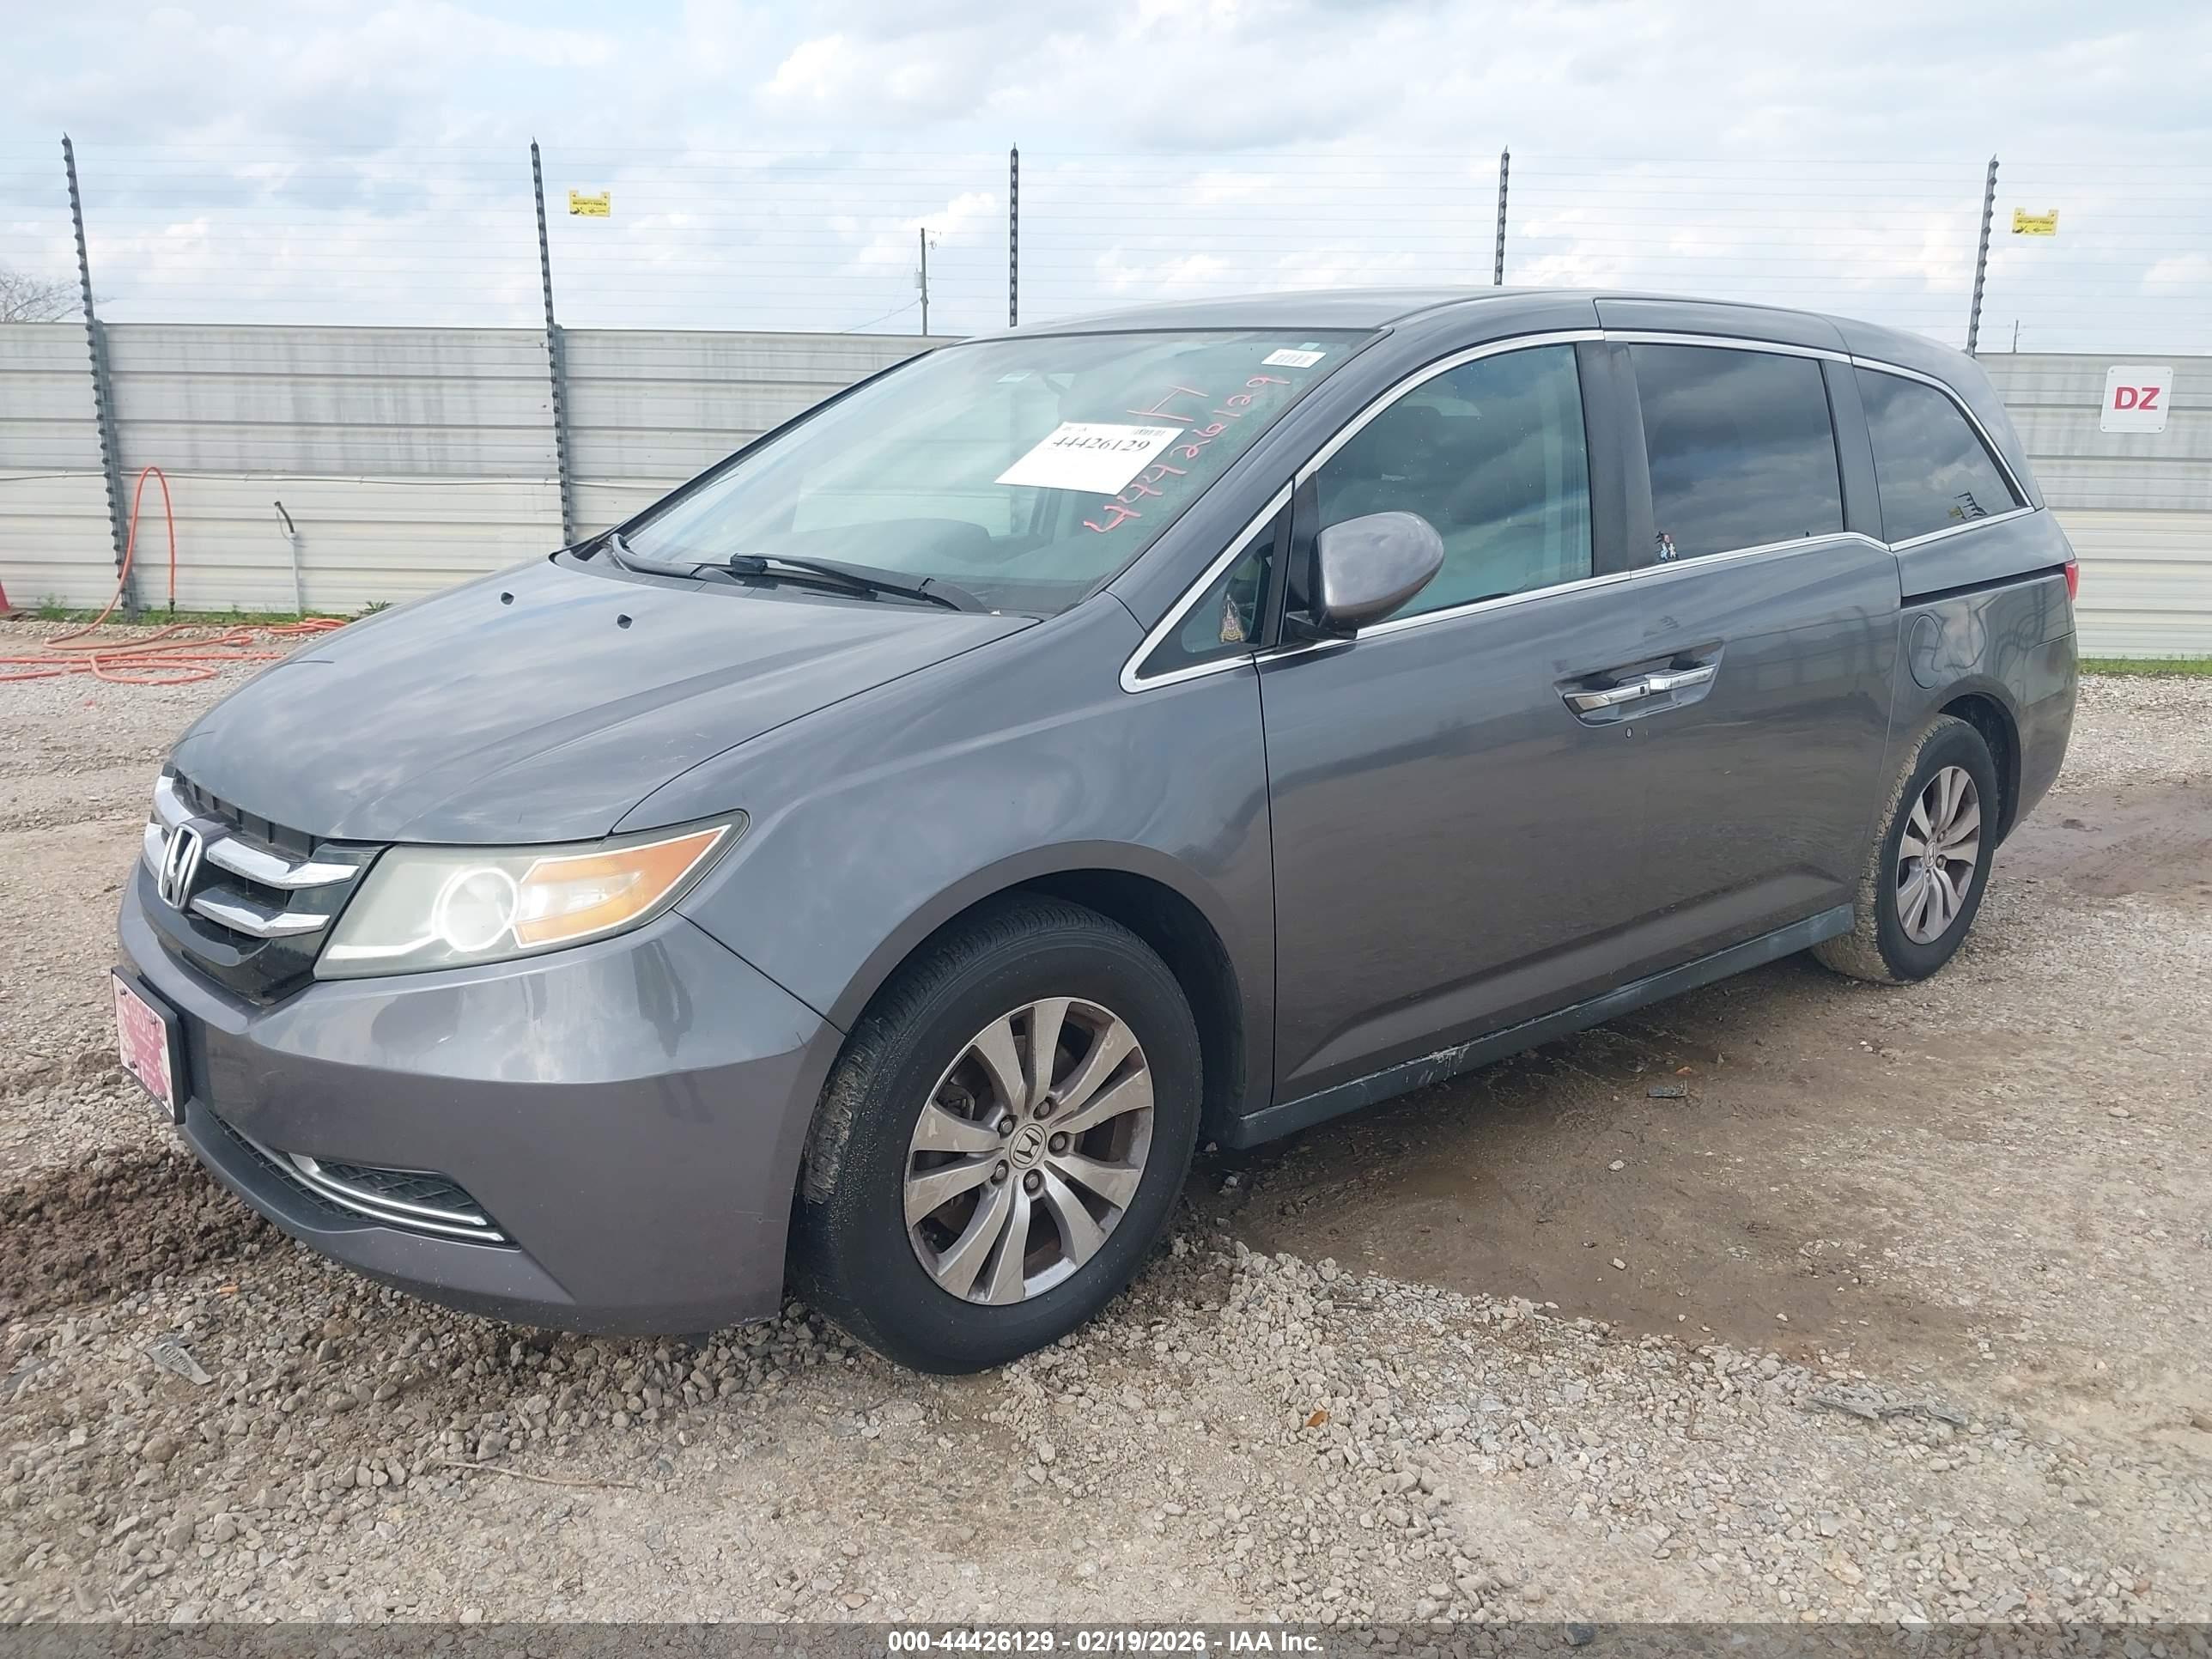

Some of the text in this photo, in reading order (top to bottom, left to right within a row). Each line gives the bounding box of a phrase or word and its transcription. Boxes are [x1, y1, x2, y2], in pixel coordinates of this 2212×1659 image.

[2115, 386, 2160, 410] DZ
[1052, 436, 1152, 453] 44426129
[1083, 376, 1291, 533] 44426129
